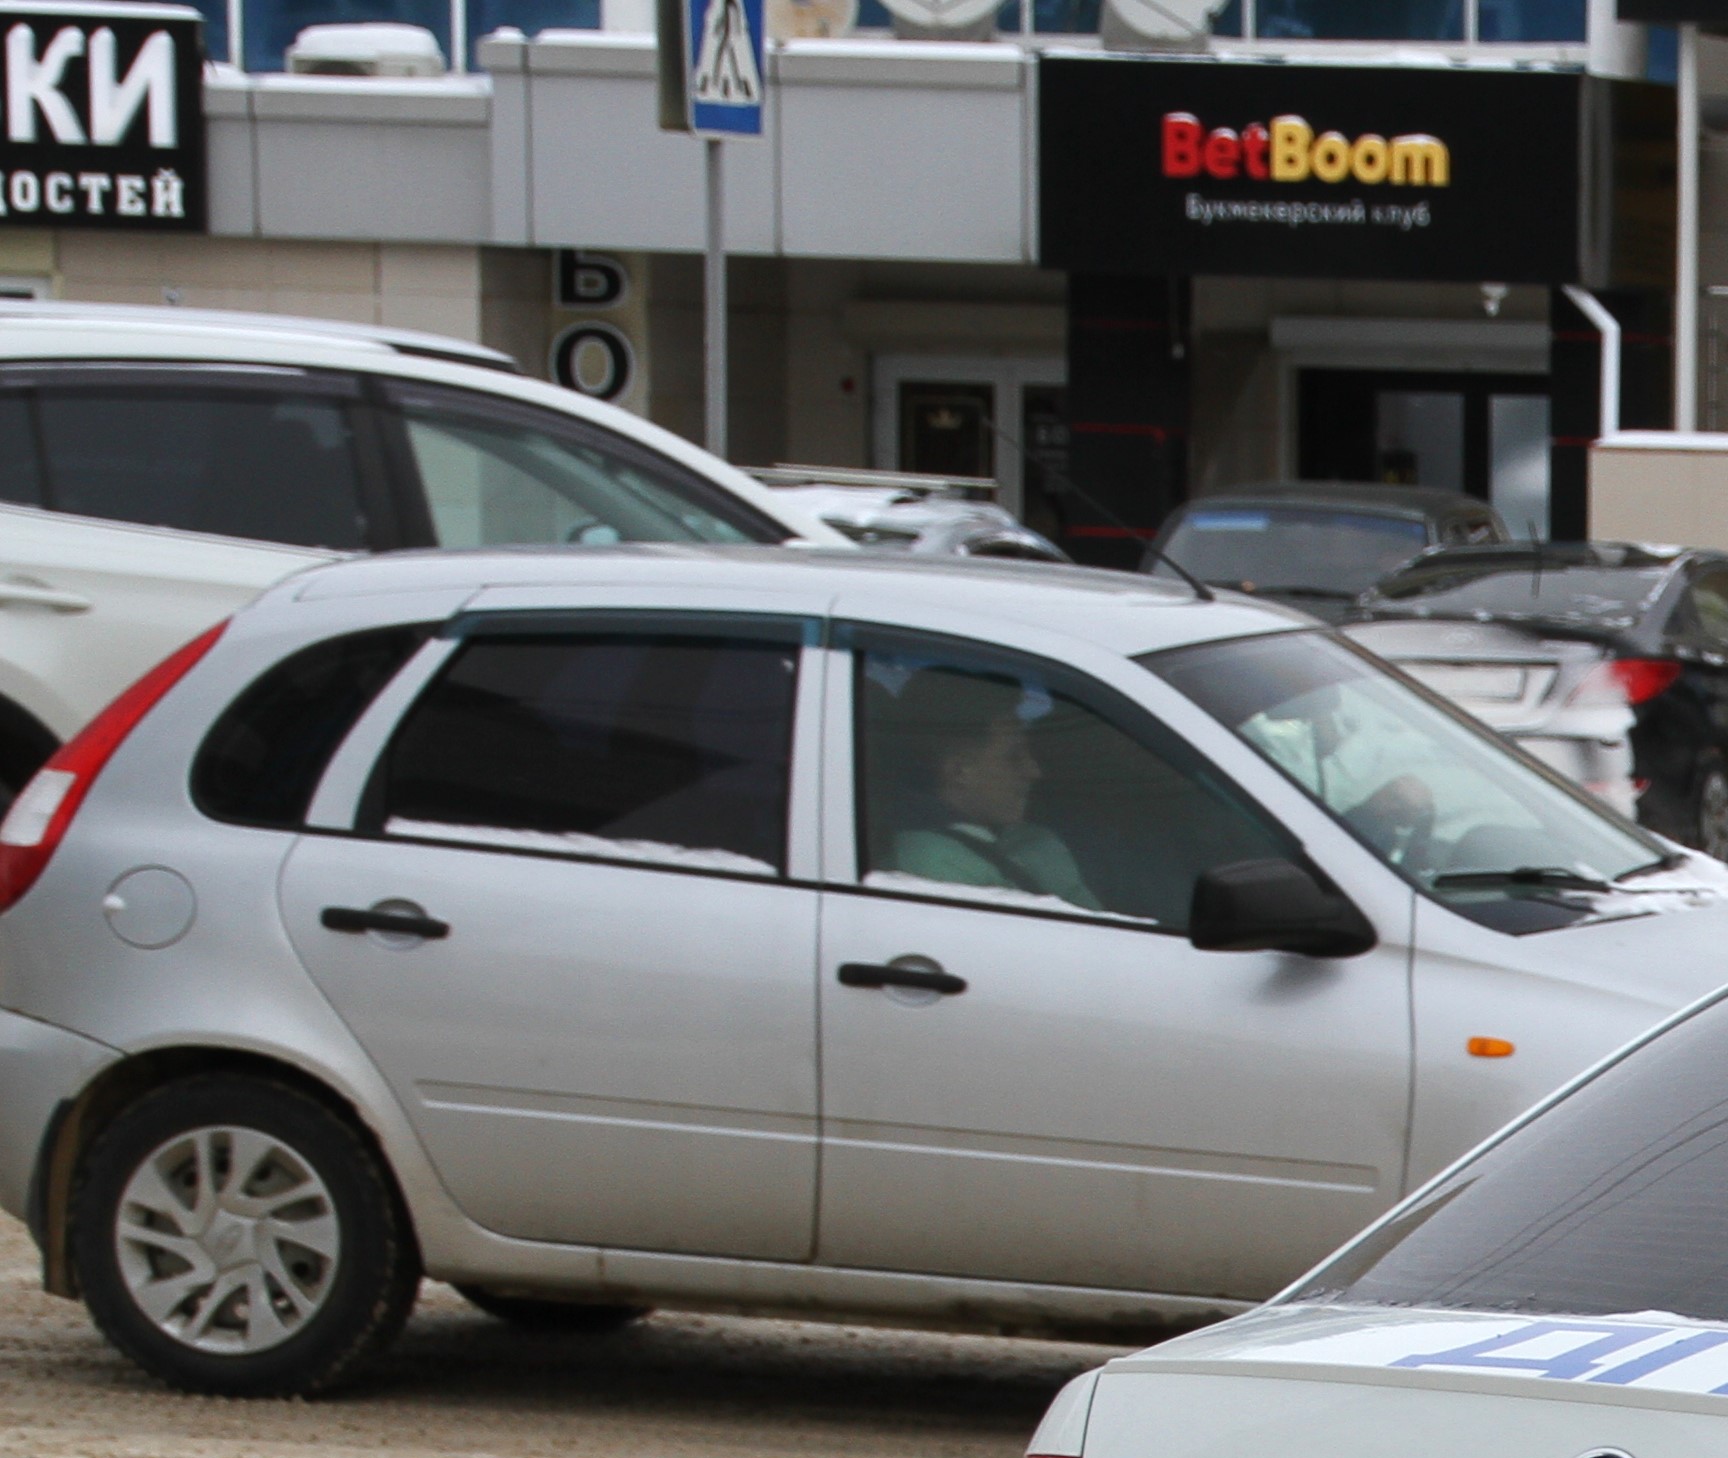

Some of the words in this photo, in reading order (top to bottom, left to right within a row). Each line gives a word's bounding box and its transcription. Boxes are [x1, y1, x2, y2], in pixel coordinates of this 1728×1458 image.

[6, 22, 177, 149] КИ
[1161, 111, 1449, 186] BetBoom
[1184, 193, 1366, 228] Букмекерский
[1371, 199, 1431, 231] клуб
